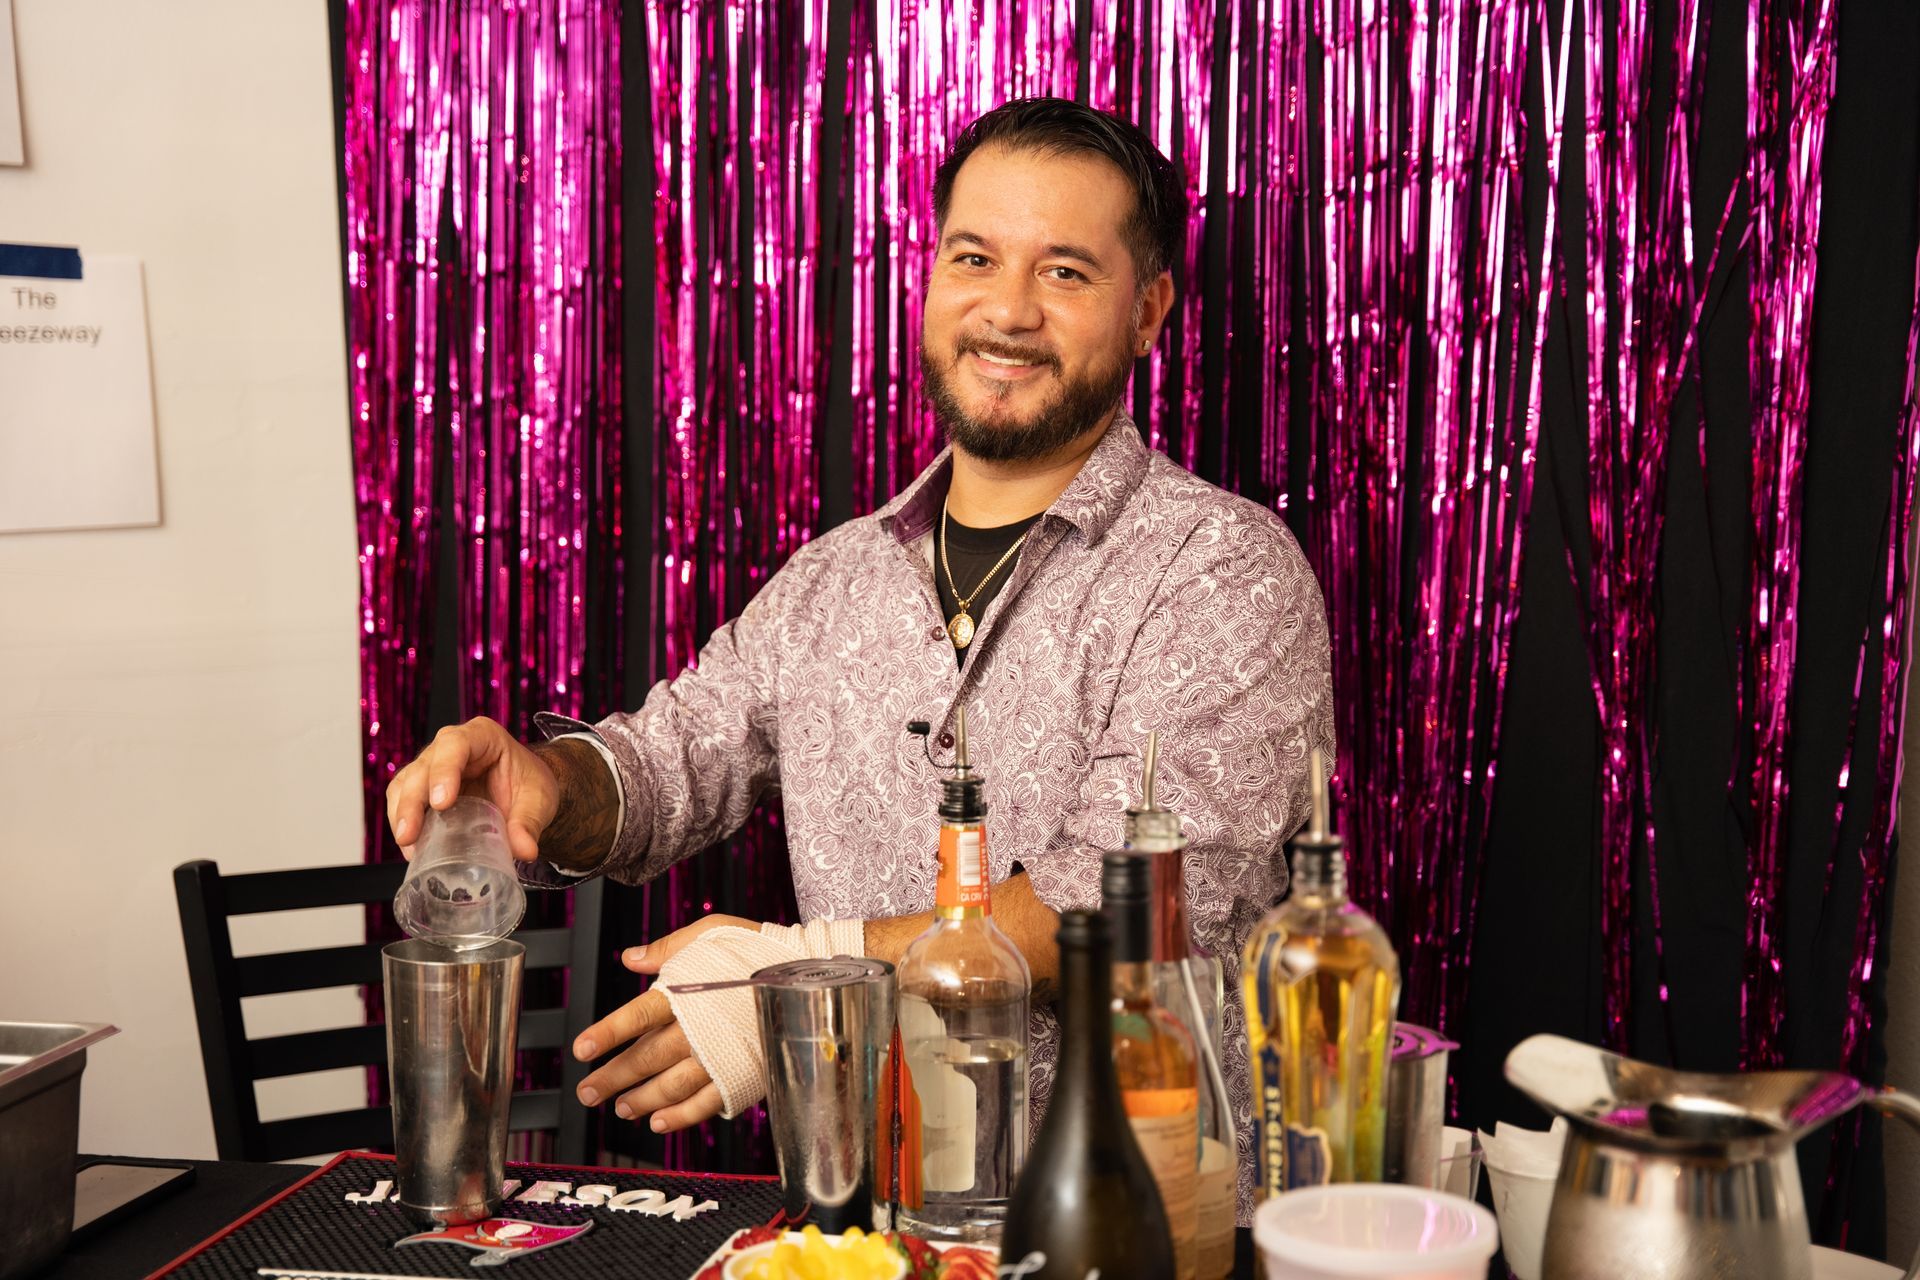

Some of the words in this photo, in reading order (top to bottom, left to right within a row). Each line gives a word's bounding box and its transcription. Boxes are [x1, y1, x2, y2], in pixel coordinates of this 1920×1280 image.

[11, 286, 57, 310] The
[0, 325, 103, 349] eezeway
[980, 843, 988, 877] TRIPLE
[982, 881, 990, 901] SEC
[345, 1180, 719, 1222] JESON
